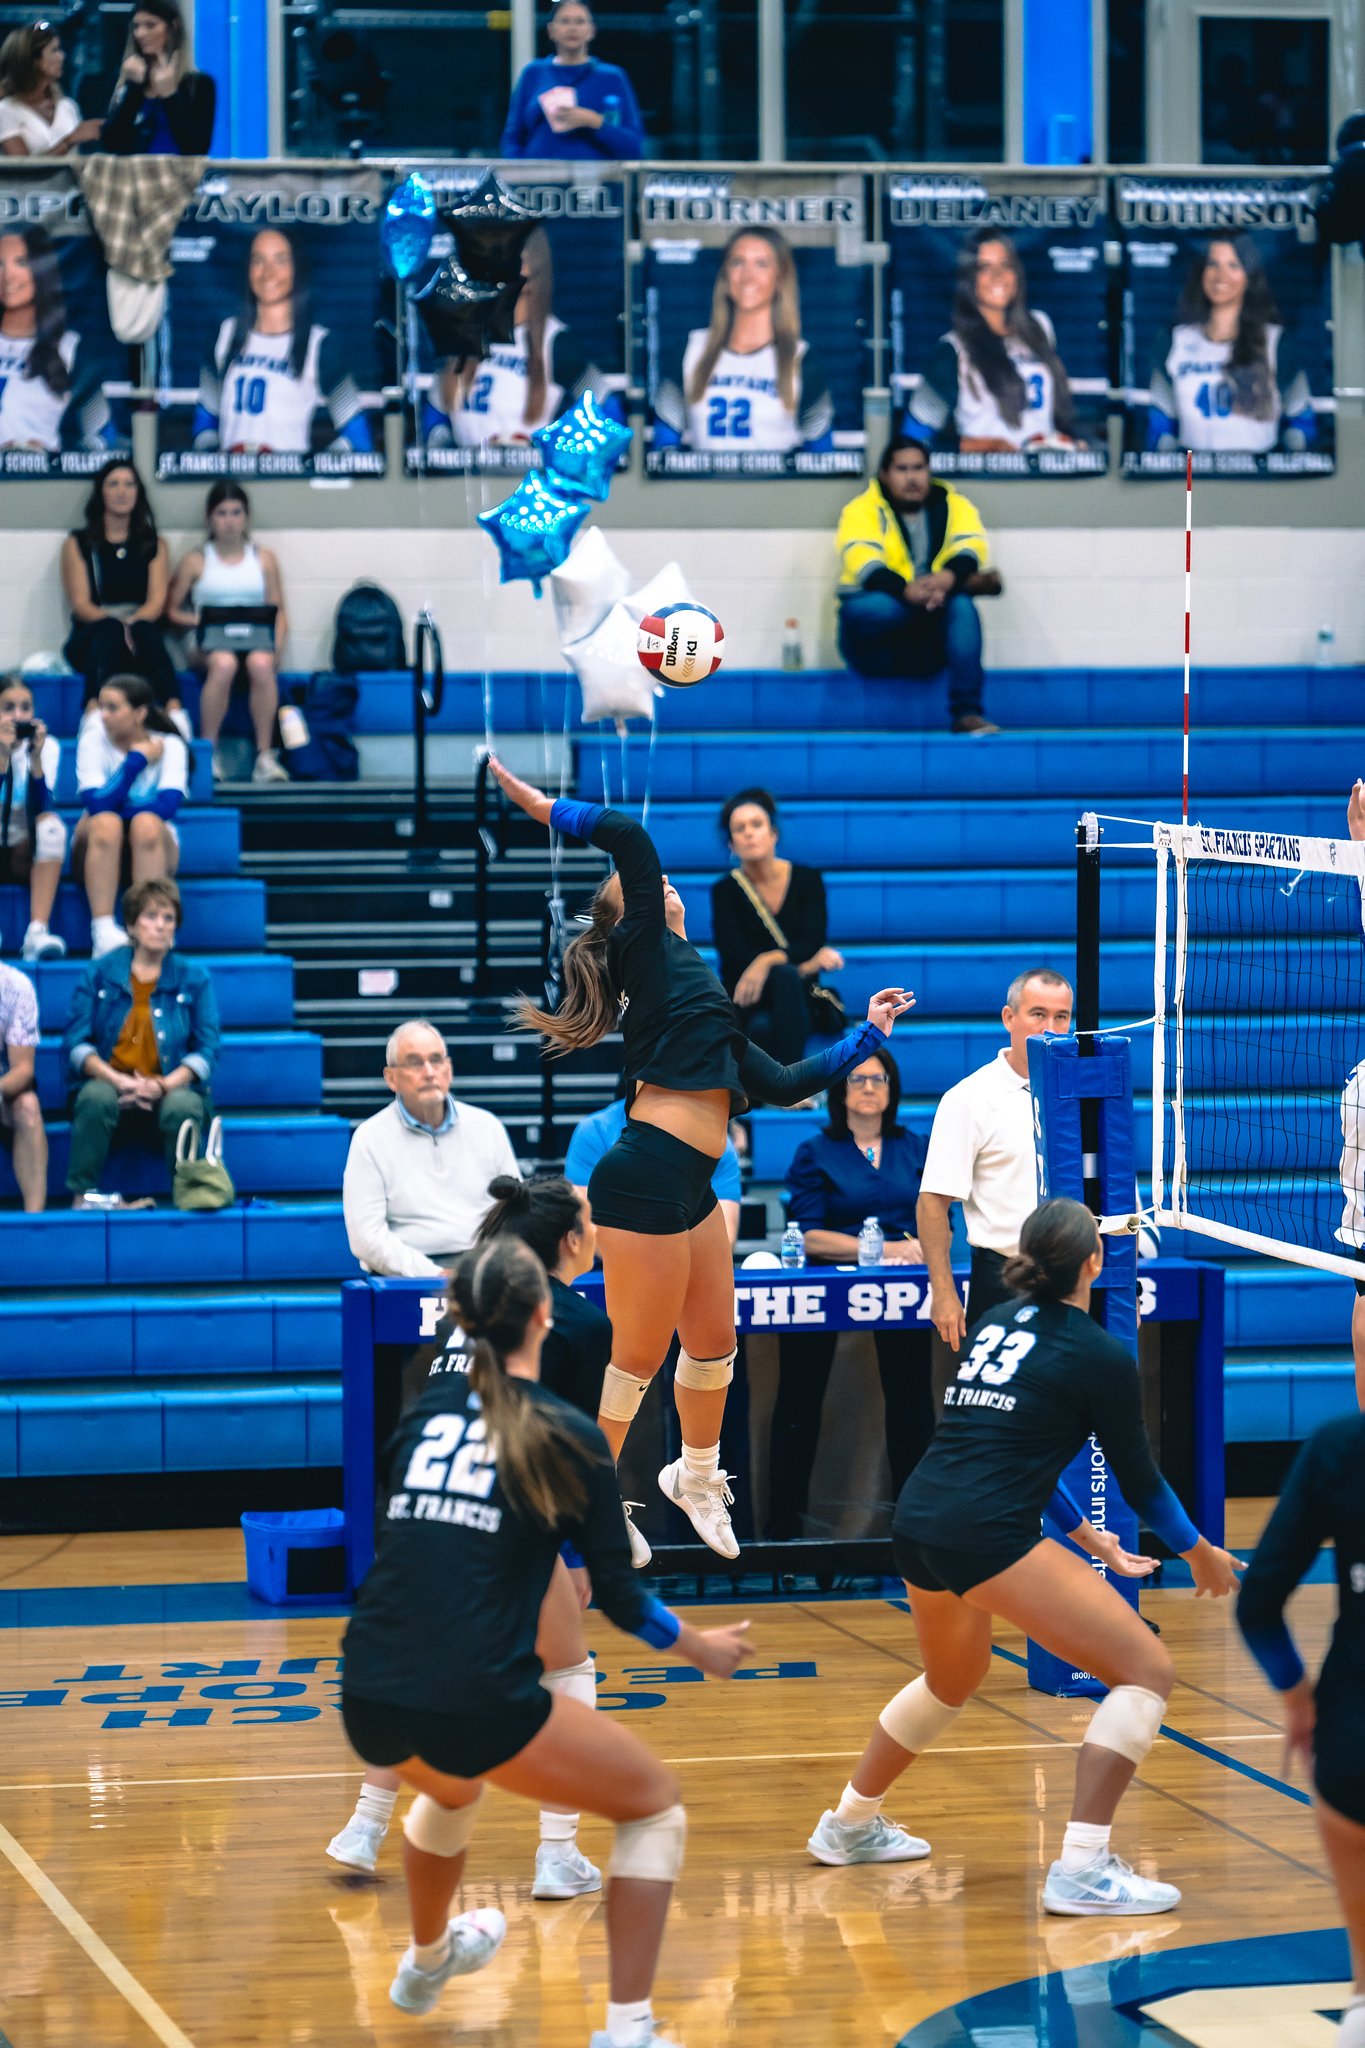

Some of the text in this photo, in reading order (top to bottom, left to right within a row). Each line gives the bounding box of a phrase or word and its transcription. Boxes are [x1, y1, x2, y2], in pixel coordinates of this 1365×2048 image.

[184, 190, 377, 225] AYLOR
[642, 195, 861, 227] HORNER
[889, 195, 1102, 228] DELANEY
[233, 375, 267, 415] 10
[1194, 381, 1232, 418] 40
[707, 396, 752, 438] 22
[666, 627, 680, 667] Wilson
[1254, 834, 1301, 862] SPARTANS
[957, 1324, 1037, 1386] 33
[944, 1386, 1017, 1412] ST. FRANCIS
[403, 1412, 497, 1499] 22
[1087, 1431, 1108, 1493] ports
[413, 1493, 502, 1534] FRANCIS
[1071, 1671, 1091, 1681] (800)
